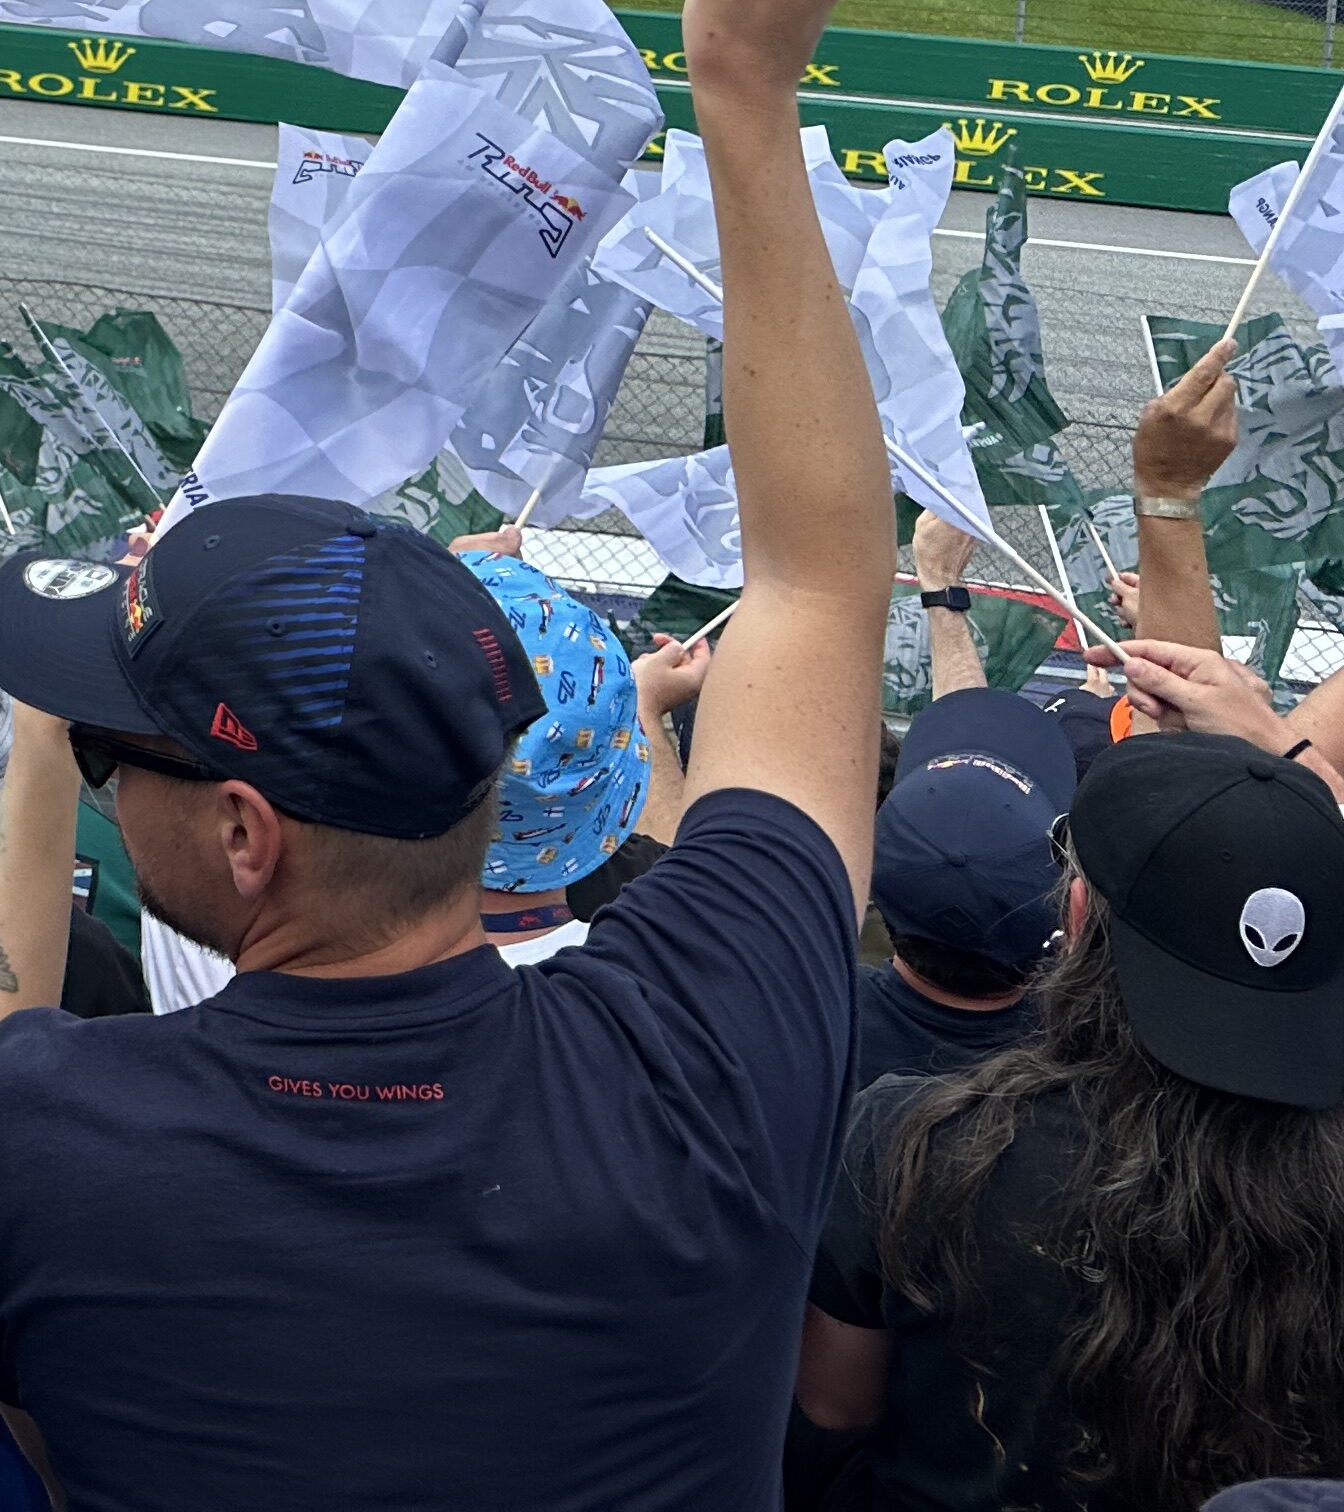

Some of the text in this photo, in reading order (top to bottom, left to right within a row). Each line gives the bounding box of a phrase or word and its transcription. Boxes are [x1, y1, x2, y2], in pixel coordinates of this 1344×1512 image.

[987, 78, 1222, 120] ROLEX
[503, 154, 553, 195] Red Bull
[842, 148, 1106, 197] RLEX
[268, 1075, 444, 1101] GIVES YOU WINGS
